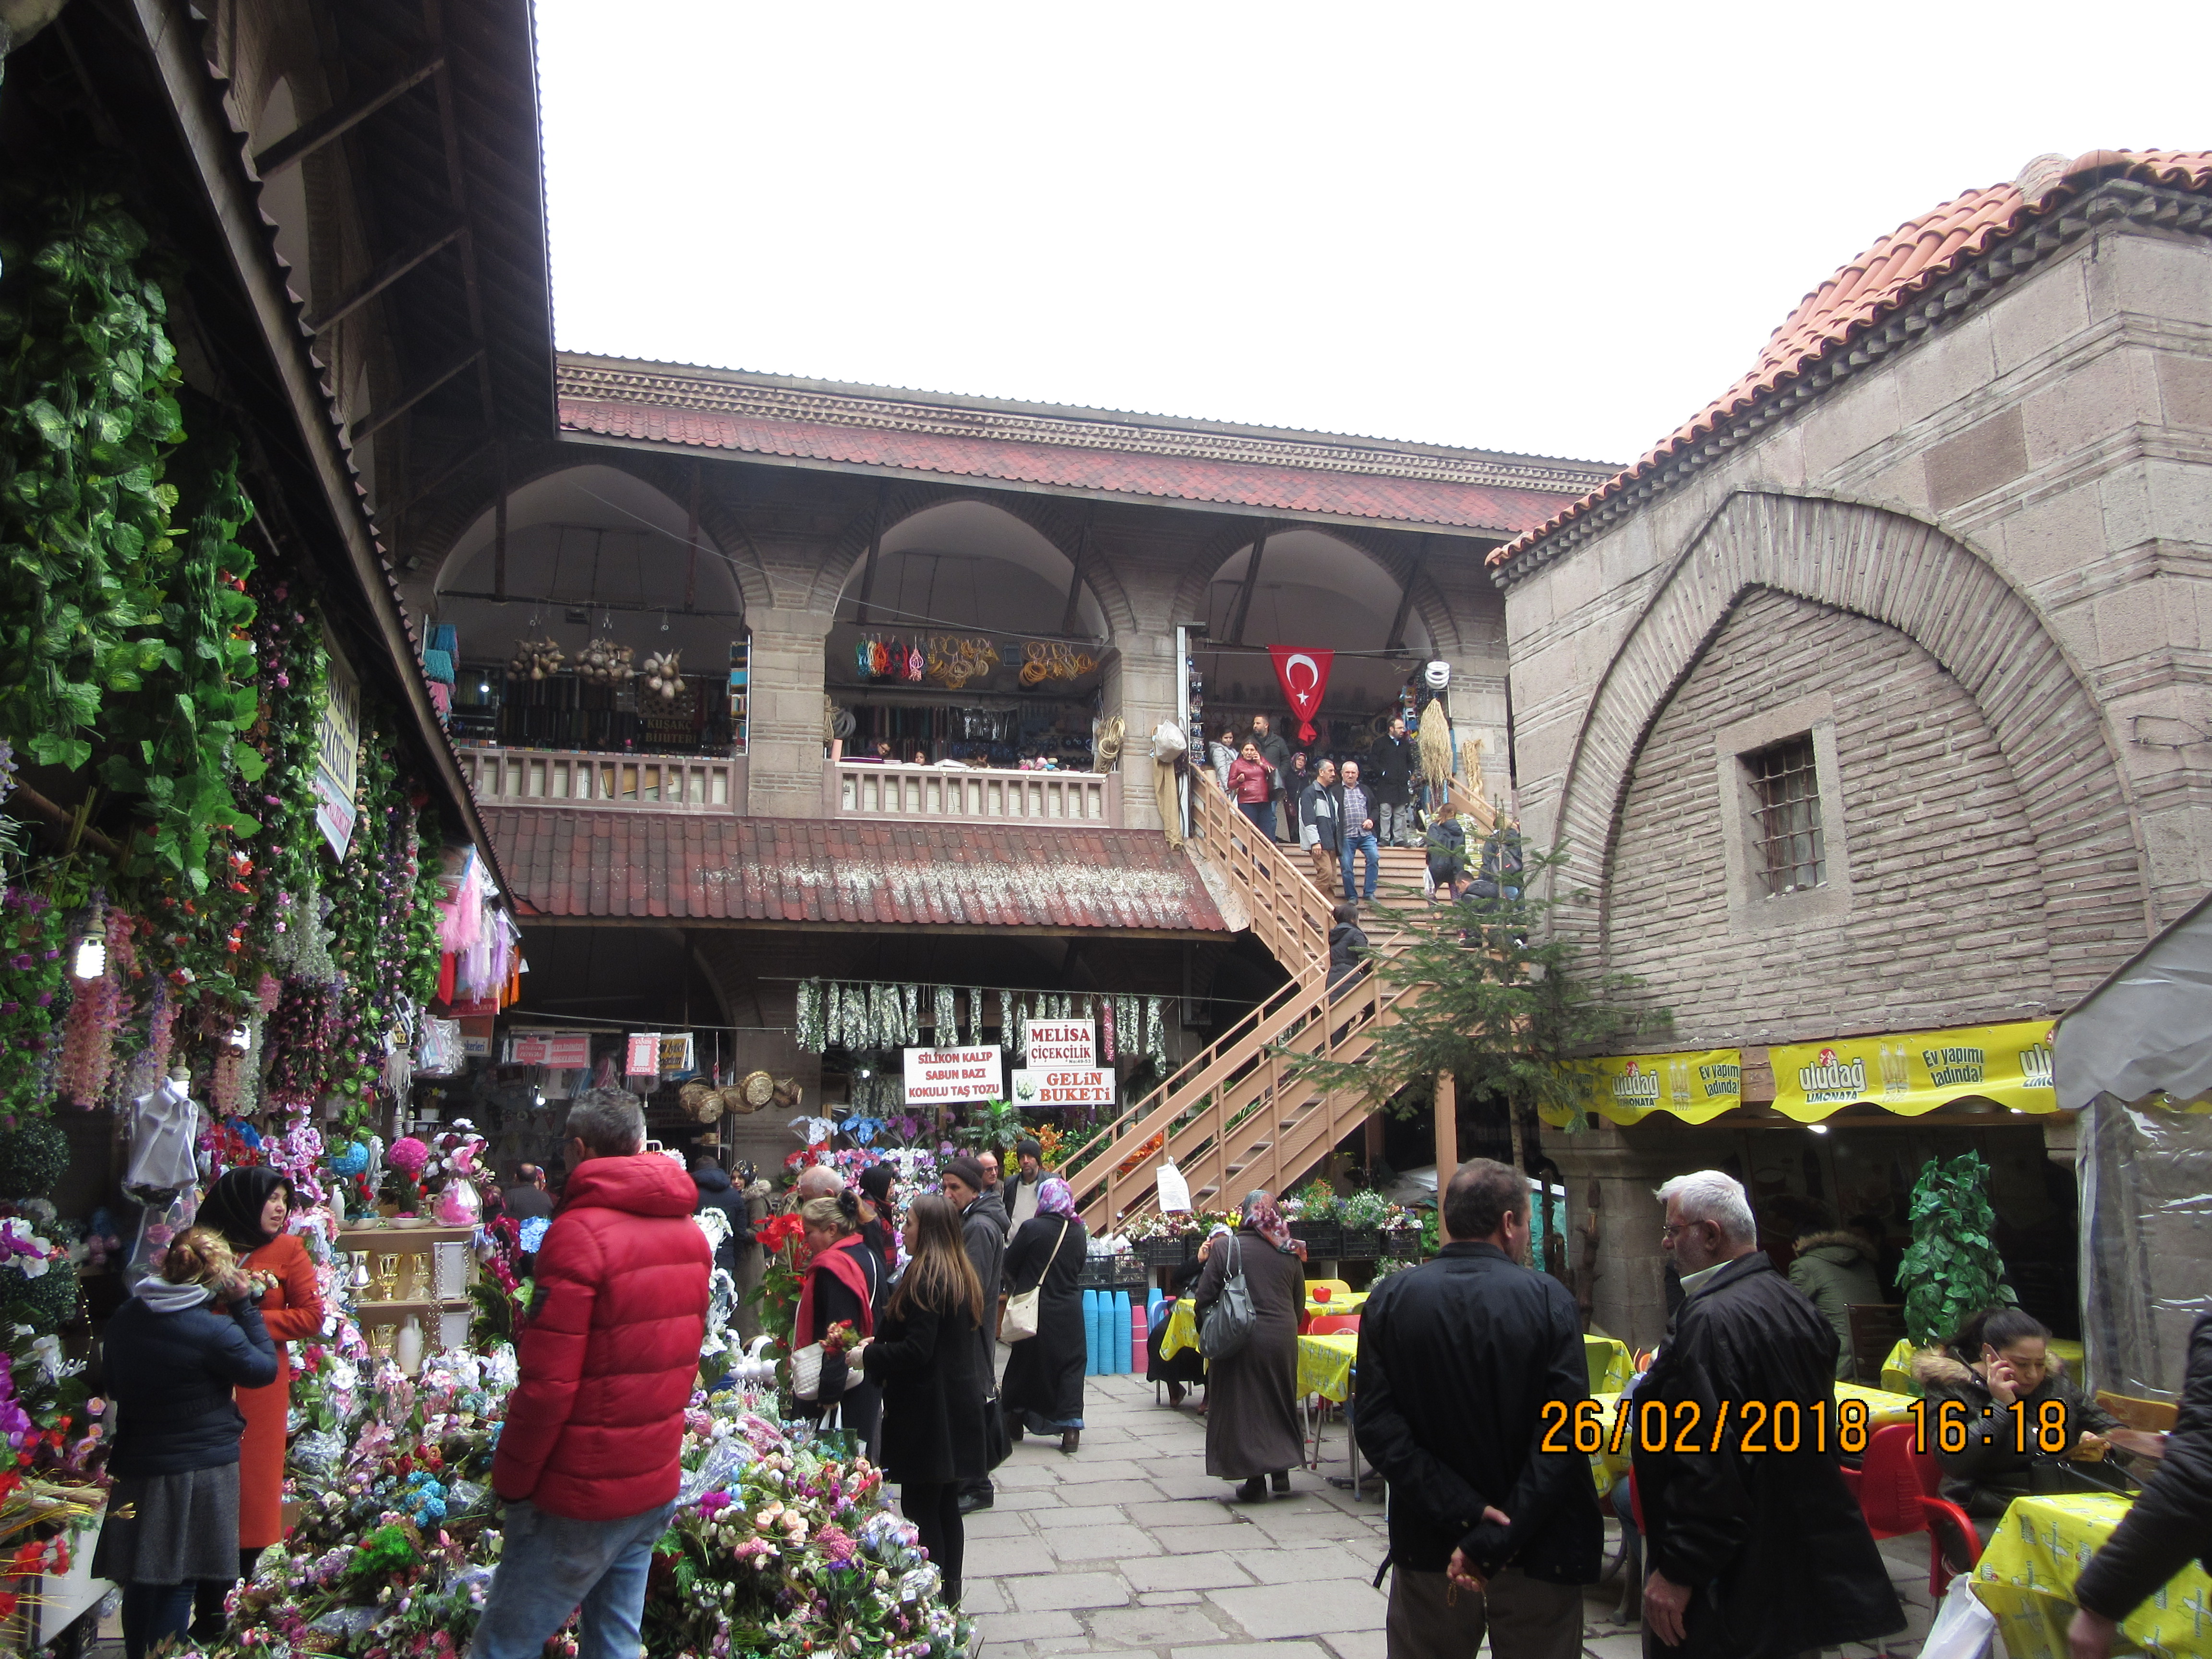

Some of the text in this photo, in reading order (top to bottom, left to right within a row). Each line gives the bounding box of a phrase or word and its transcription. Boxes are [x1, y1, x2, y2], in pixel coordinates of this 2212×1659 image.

[1031, 1024, 1091, 1042] MELİSA
[918, 1051, 993, 1064] SİLİKON KALIP
[1031, 1045, 1091, 1063] ÇİÇEKÇİLİK
[1922, 1047, 1984, 1068] Ev yapımı
[926, 1068, 986, 1080] SABUN BAZI
[1698, 1065, 1710, 1081] Ev
[1799, 1057, 1866, 1092] uludağ
[1931, 1065, 1983, 1088] tadında!
[909, 1083, 999, 1097] KOKULU TAŞ TOZU
[1612, 1070, 1660, 1098] uludağ
